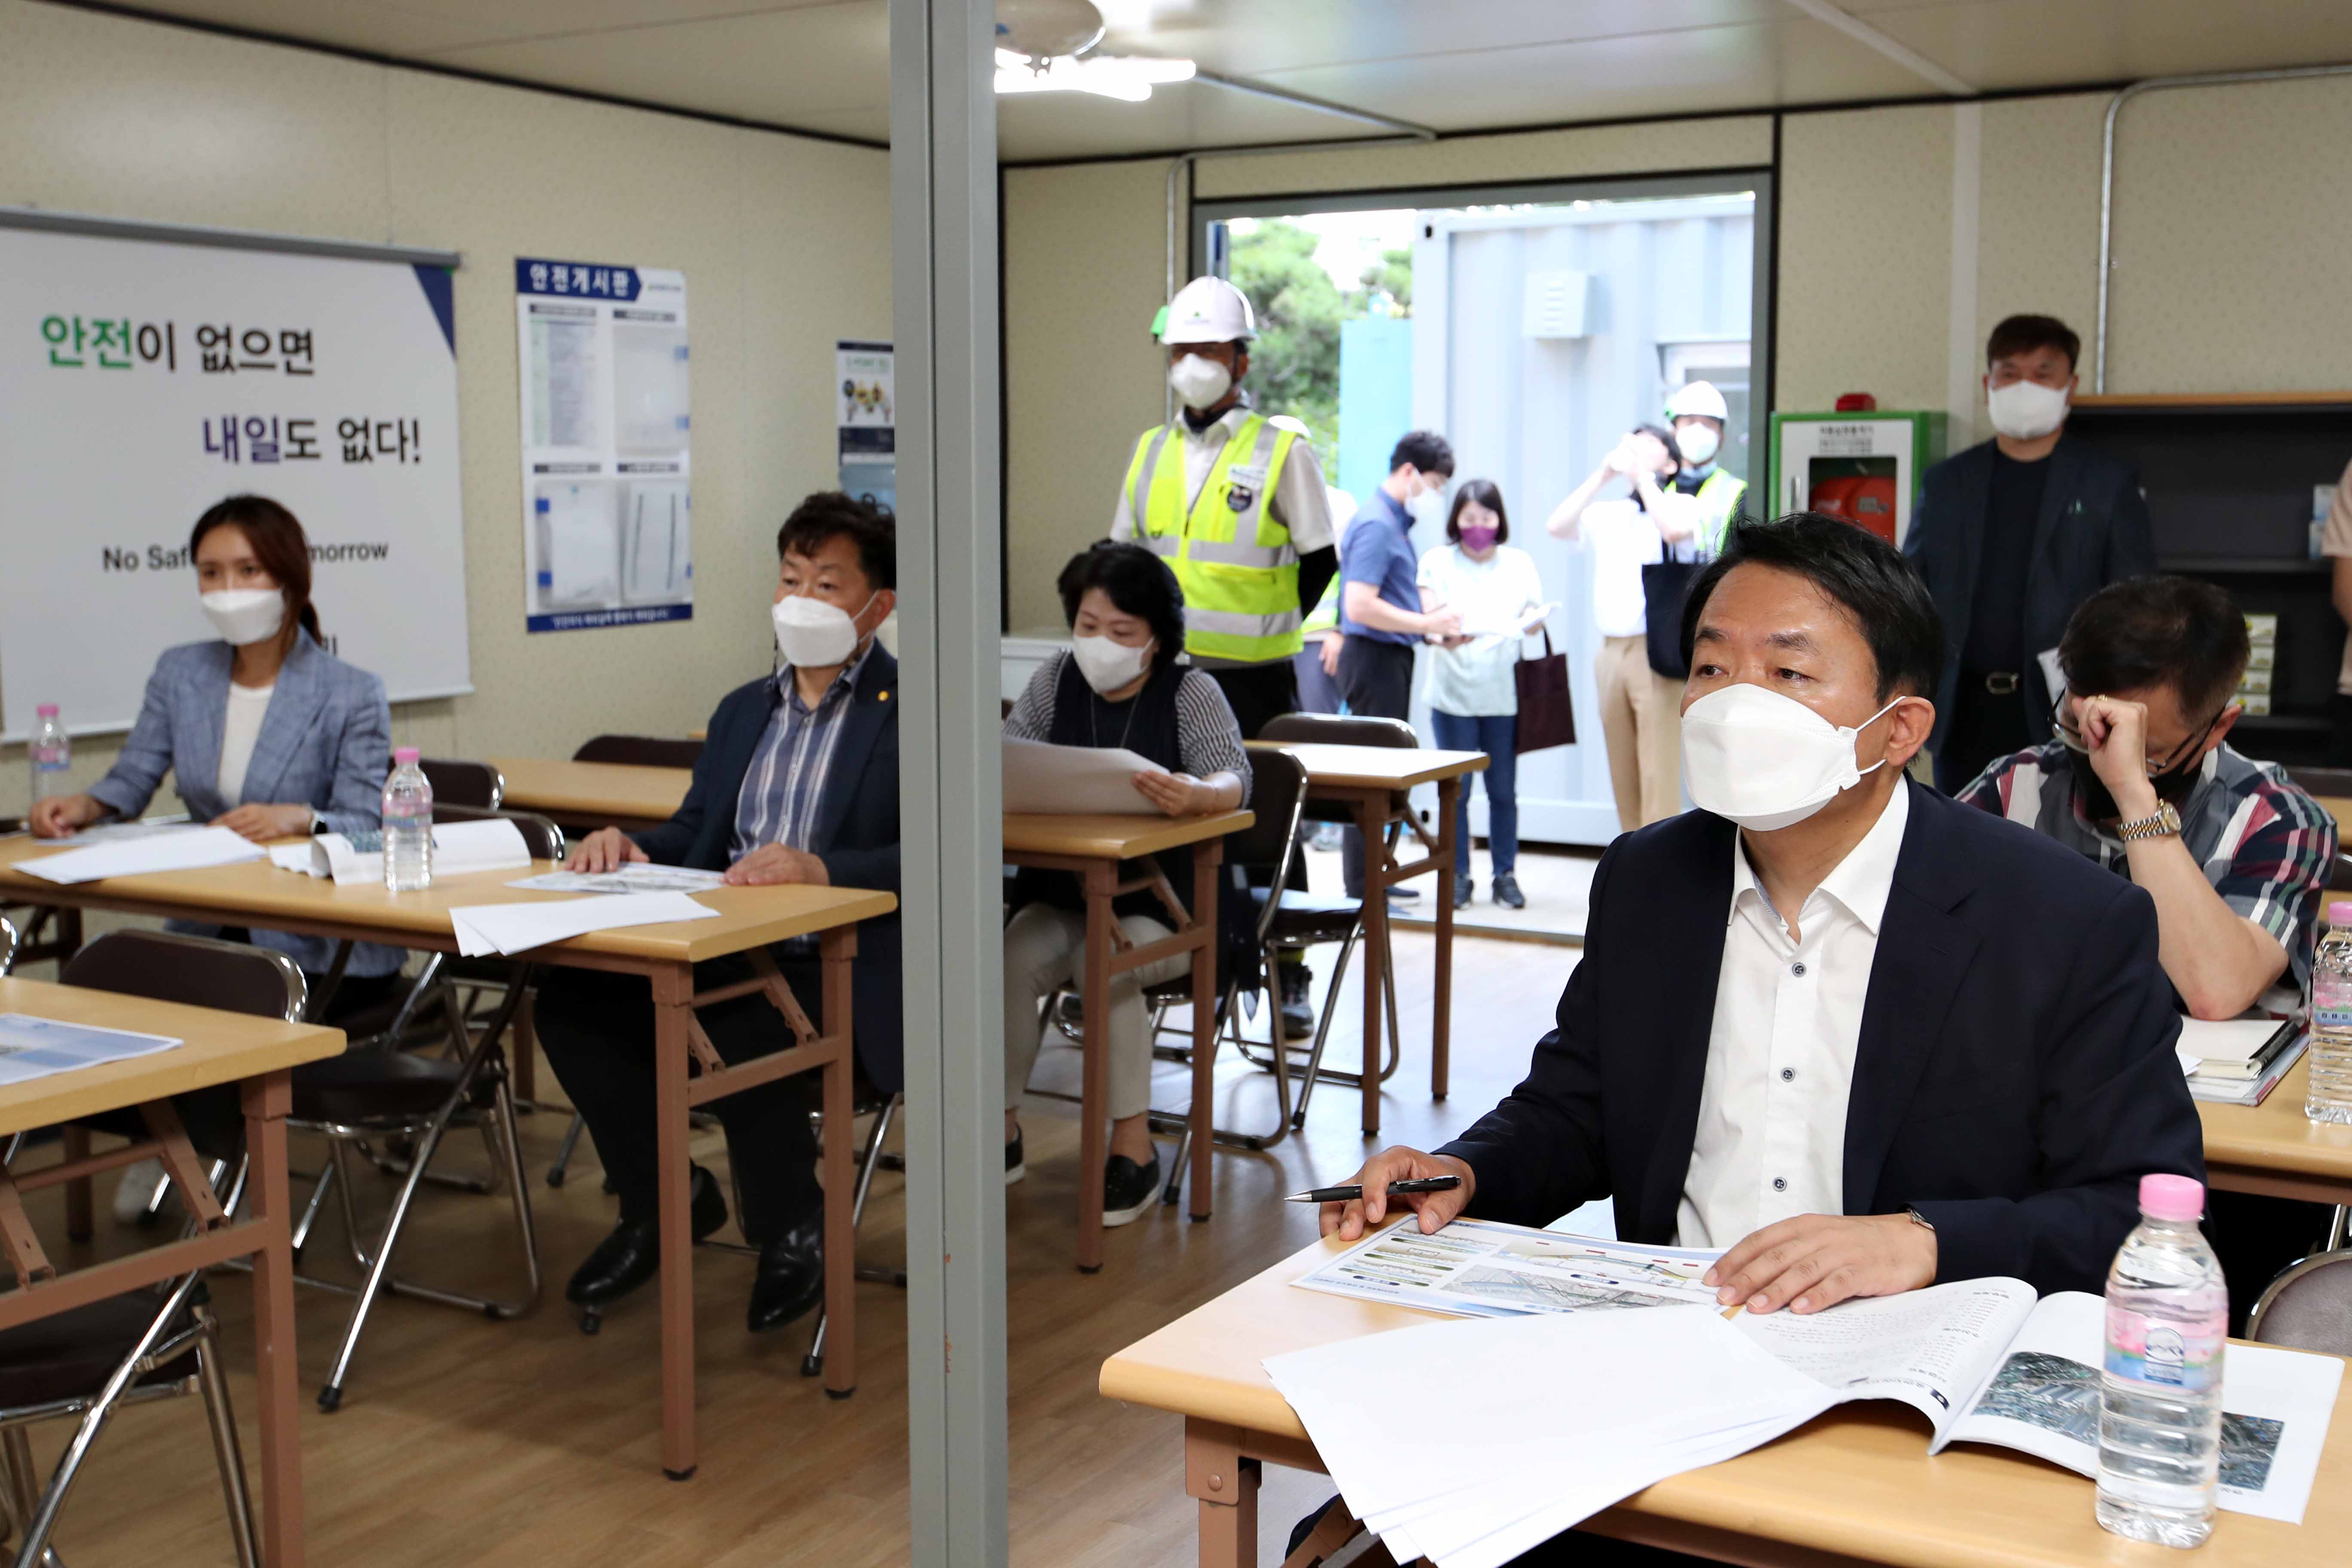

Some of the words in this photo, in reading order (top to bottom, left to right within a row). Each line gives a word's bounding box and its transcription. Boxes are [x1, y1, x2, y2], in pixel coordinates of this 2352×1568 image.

[529, 263, 629, 297] 안전게시판
[41, 314, 176, 373] 안전이
[196, 325, 315, 376] 없으면
[203, 416, 322, 465] 내일도
[337, 417, 422, 465] 없다!
[103, 548, 140, 573] No
[147, 543, 190, 571] Saf
[308, 541, 389, 563] morrow
